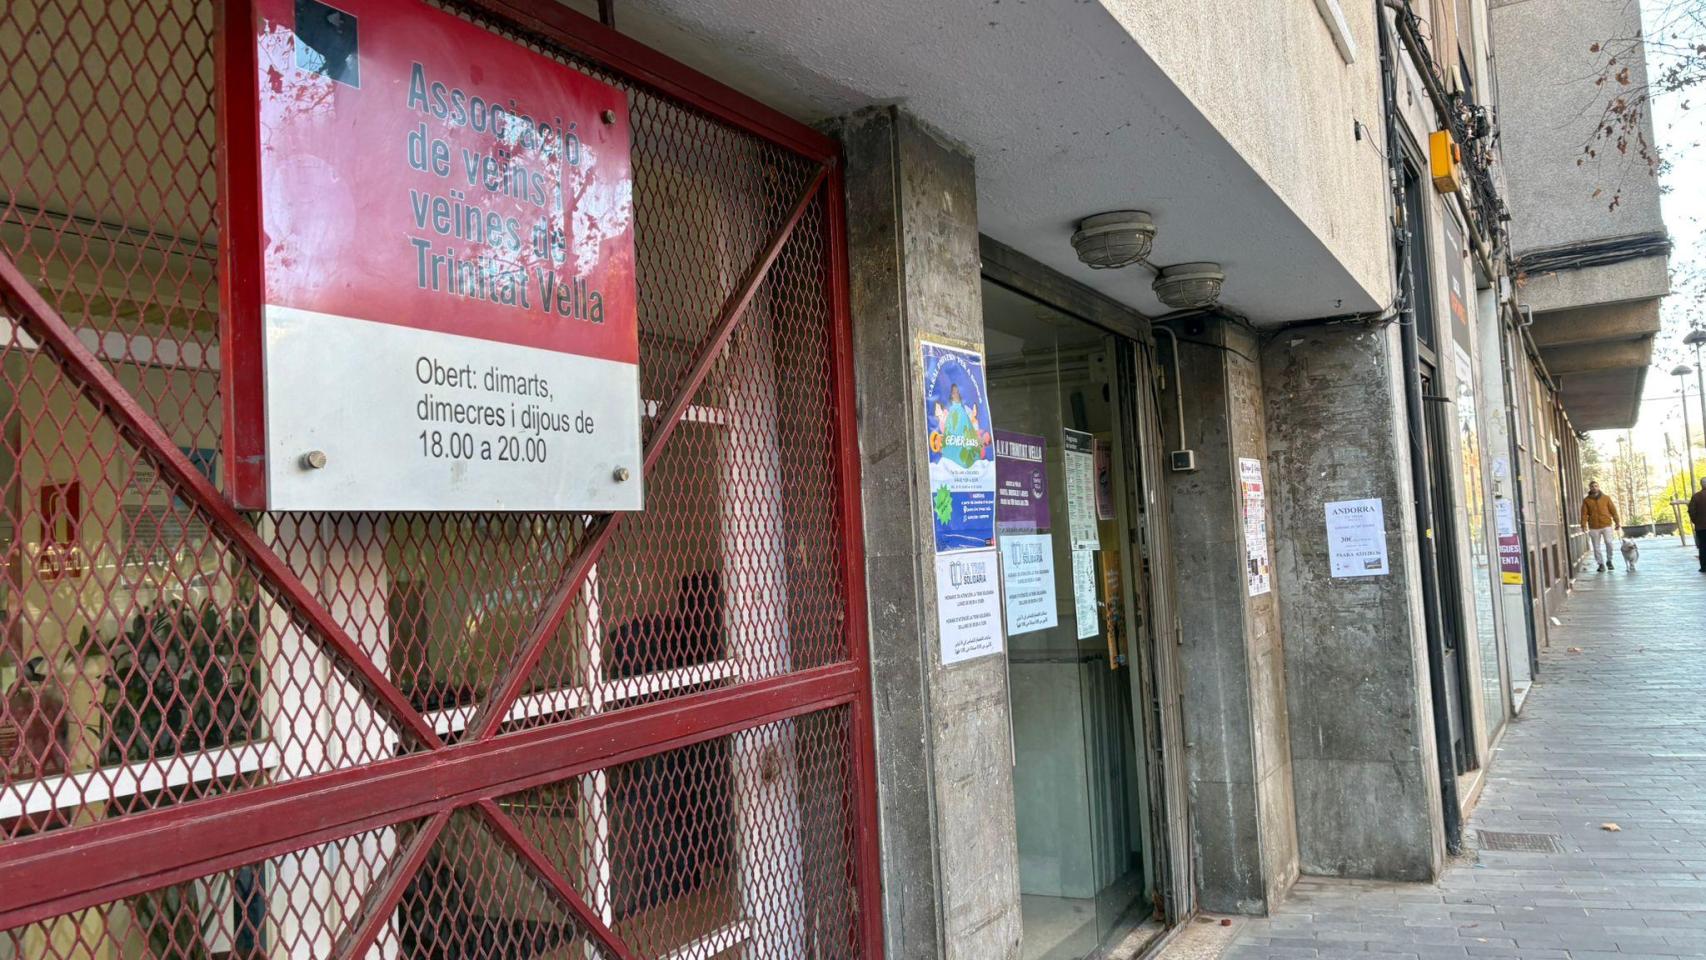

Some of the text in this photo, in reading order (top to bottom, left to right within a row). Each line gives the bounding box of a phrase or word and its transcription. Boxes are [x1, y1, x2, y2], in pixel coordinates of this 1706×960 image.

[408, 61, 581, 167] Associació
[408, 123, 449, 178] de
[463, 147, 547, 208] veïns
[410, 188, 567, 263] veïnes de
[410, 236, 605, 324] Trinitat Vella
[416, 356, 554, 402] Obert: dimarts,
[417, 394, 595, 437] dimecres i dijous de
[419, 430, 547, 464] 18.00 a 20.00
[945, 435, 965, 448] GENER
[1332, 505, 1376, 516] ANDORRA
